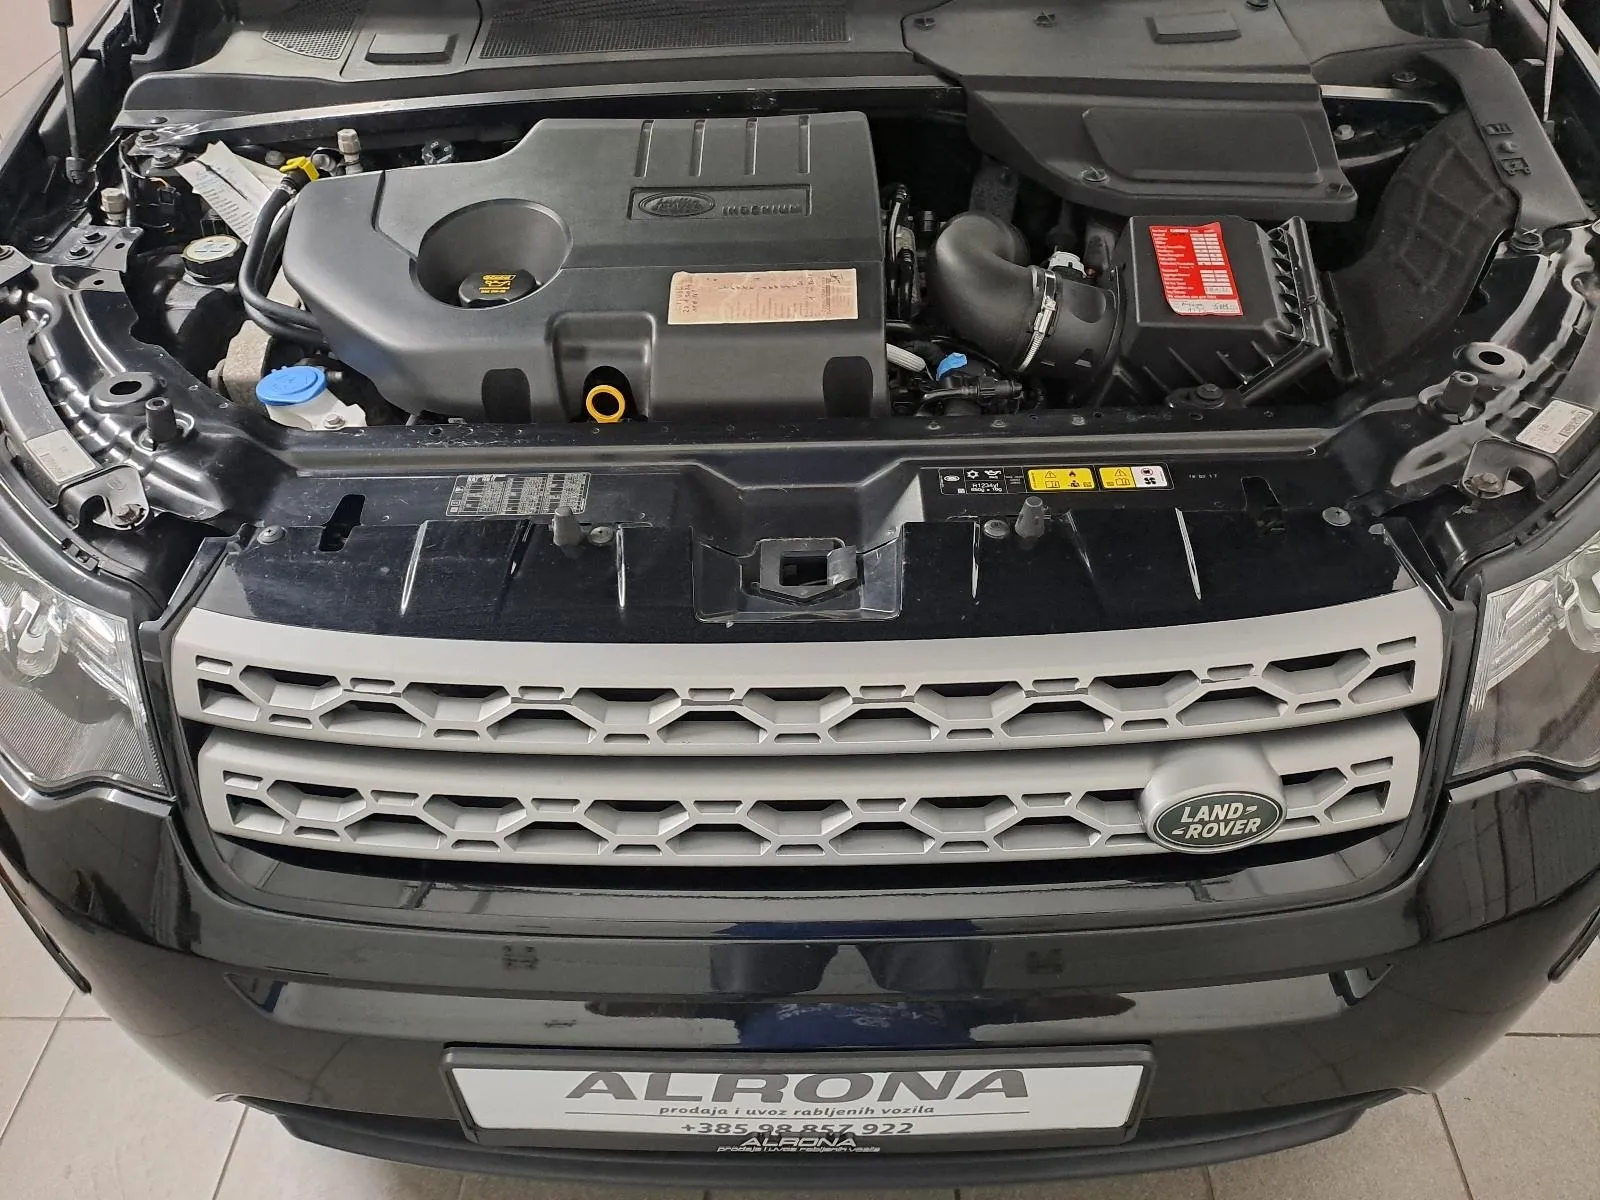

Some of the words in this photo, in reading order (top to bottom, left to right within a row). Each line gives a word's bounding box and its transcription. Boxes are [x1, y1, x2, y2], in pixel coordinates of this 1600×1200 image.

[1180, 802, 1244, 823] LAND
[1184, 818, 1262, 839] ROVER
[565, 1069, 1030, 1103] ALRONA
[659, 1105, 728, 1117] prodaja
[746, 1108, 787, 1116] uvoz
[793, 1107, 876, 1118] rabljenih
[881, 1105, 935, 1115] vozila
[681, 1122, 749, 1135] +385
[757, 1123, 793, 1135] 98
[802, 1123, 855, 1135] 857
[861, 1122, 914, 1135] 922
